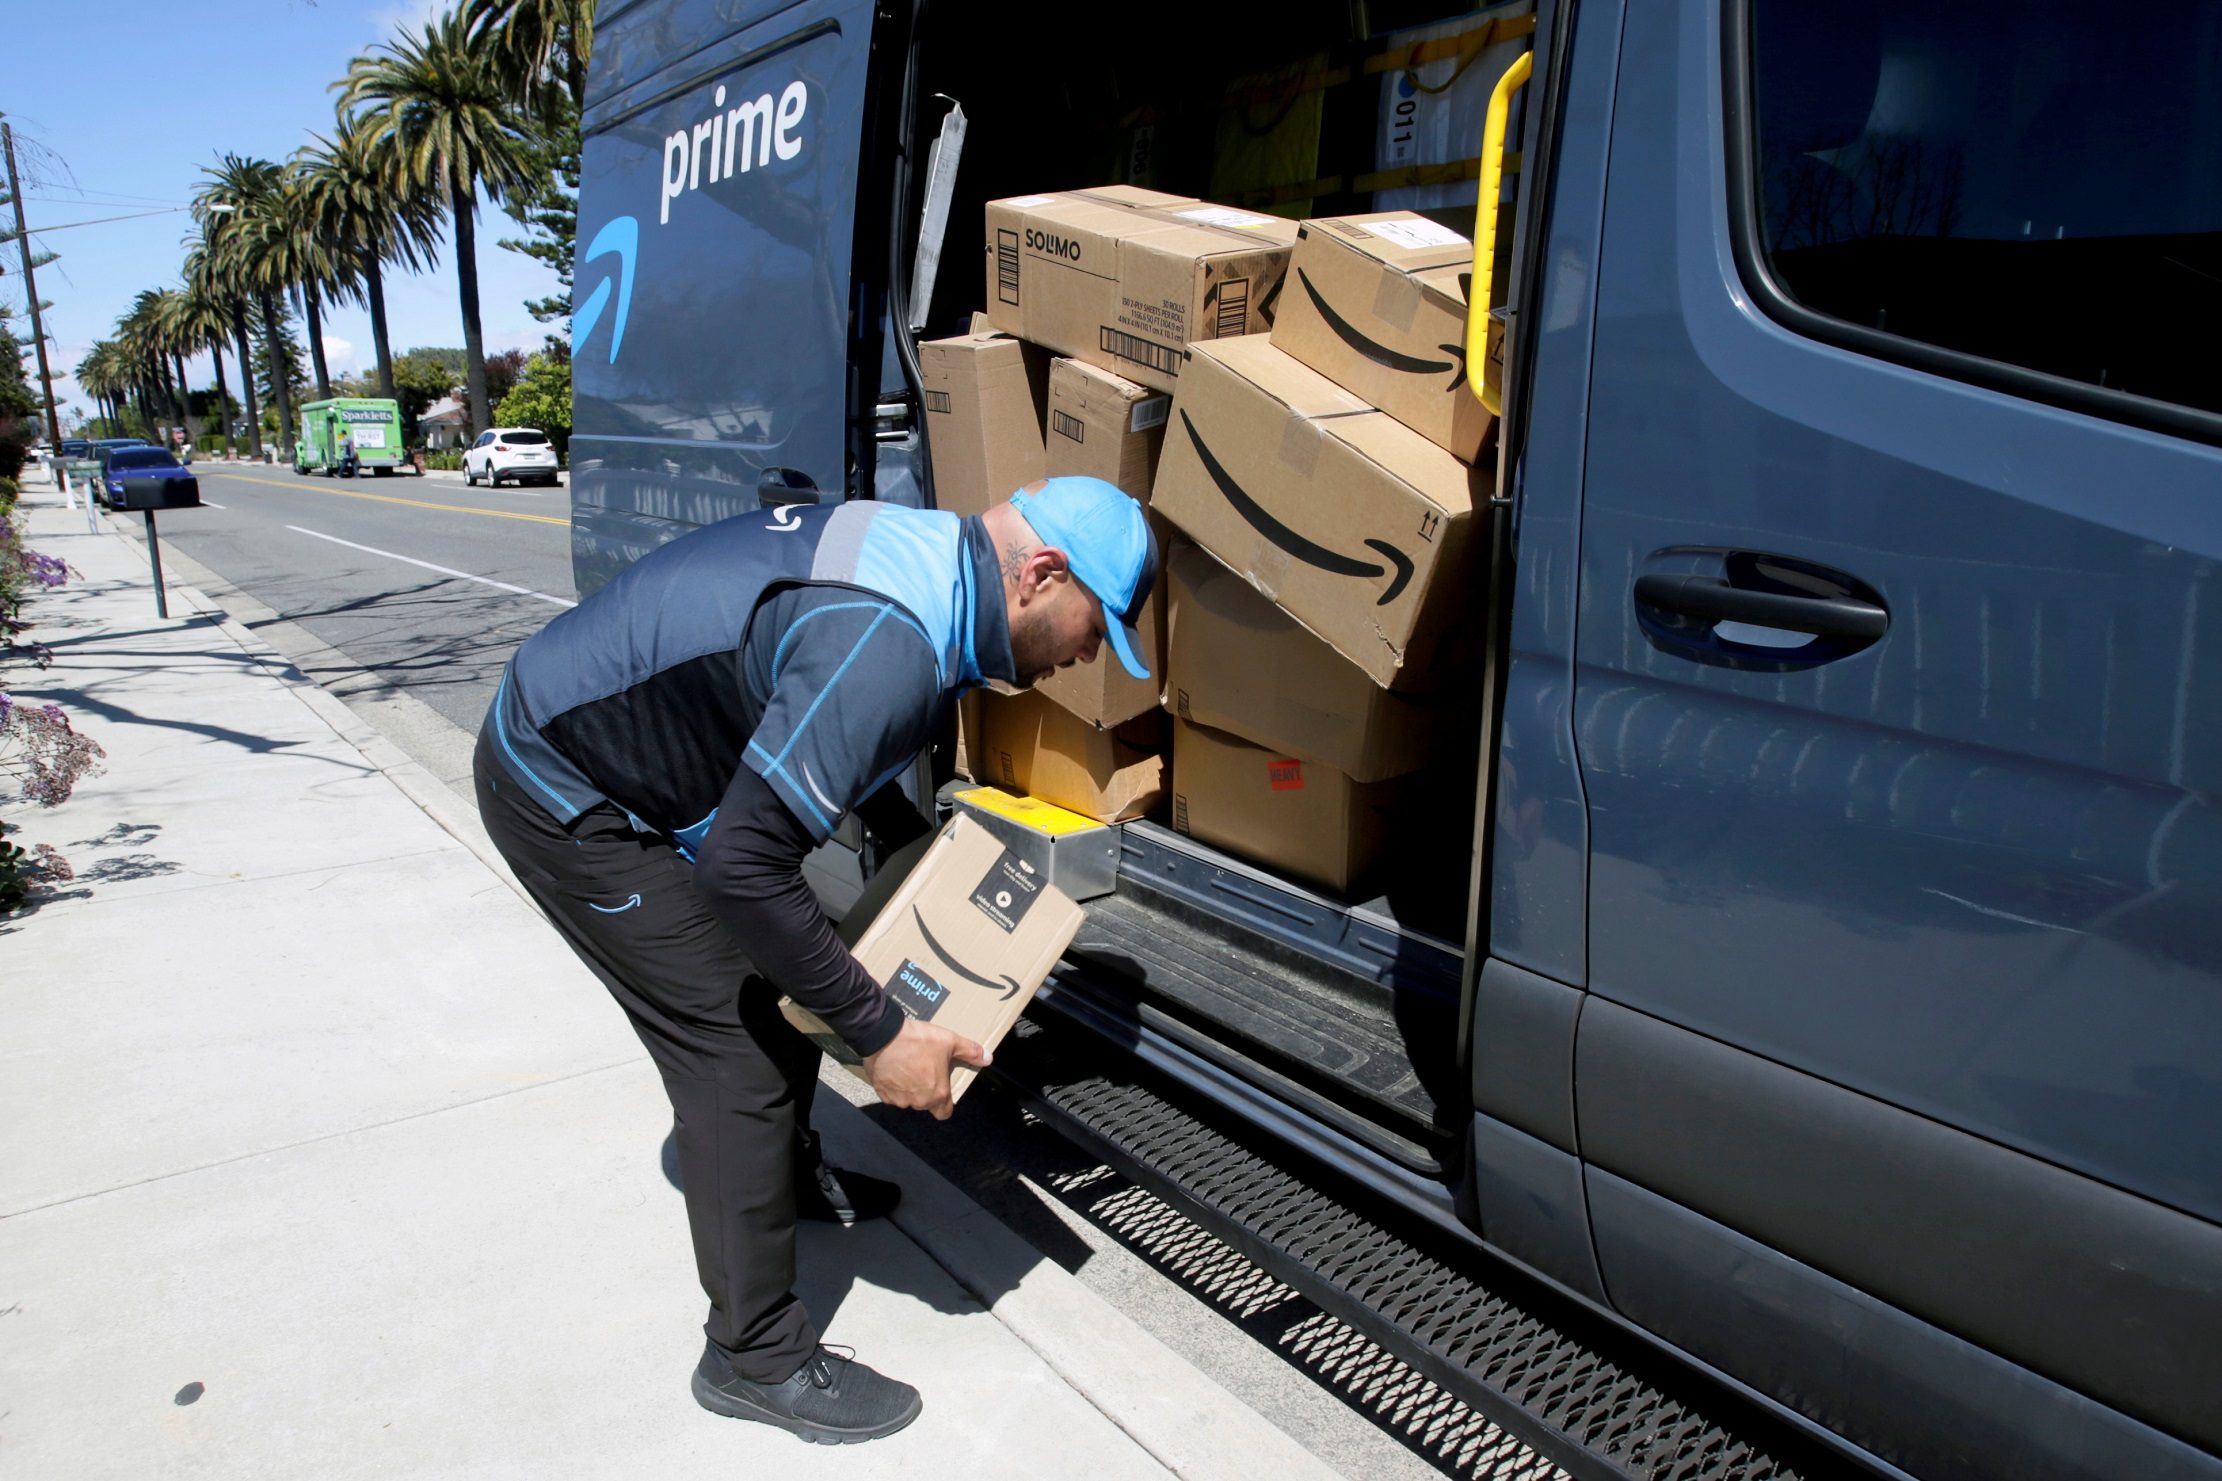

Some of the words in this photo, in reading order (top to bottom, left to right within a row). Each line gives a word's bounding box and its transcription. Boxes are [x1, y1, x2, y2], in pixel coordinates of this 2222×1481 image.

[1393, 101, 1416, 142] 011
[660, 80, 808, 225] prime
[1025, 228, 1081, 261] SOLIMO
[1130, 299, 1143, 310] 2-PLY
[1143, 303, 1161, 316] SHEETS
[1161, 308, 1171, 319] PER
[1171, 311, 1184, 323] ROLL
[1146, 313, 1154, 324] SQ
[1154, 316, 1160, 325] FT
[1162, 299, 1169, 309] 30
[1169, 301, 1185, 313] ROLLS
[342, 410, 393, 421] Sparkletts
[1270, 767, 1301, 781] HEAVY
[1003, 861, 1016, 875] free
[1015, 871, 1037, 892] delivery
[976, 894, 990, 908] video
[990, 905, 1015, 928] streaming
[900, 969, 941, 1003] prime
